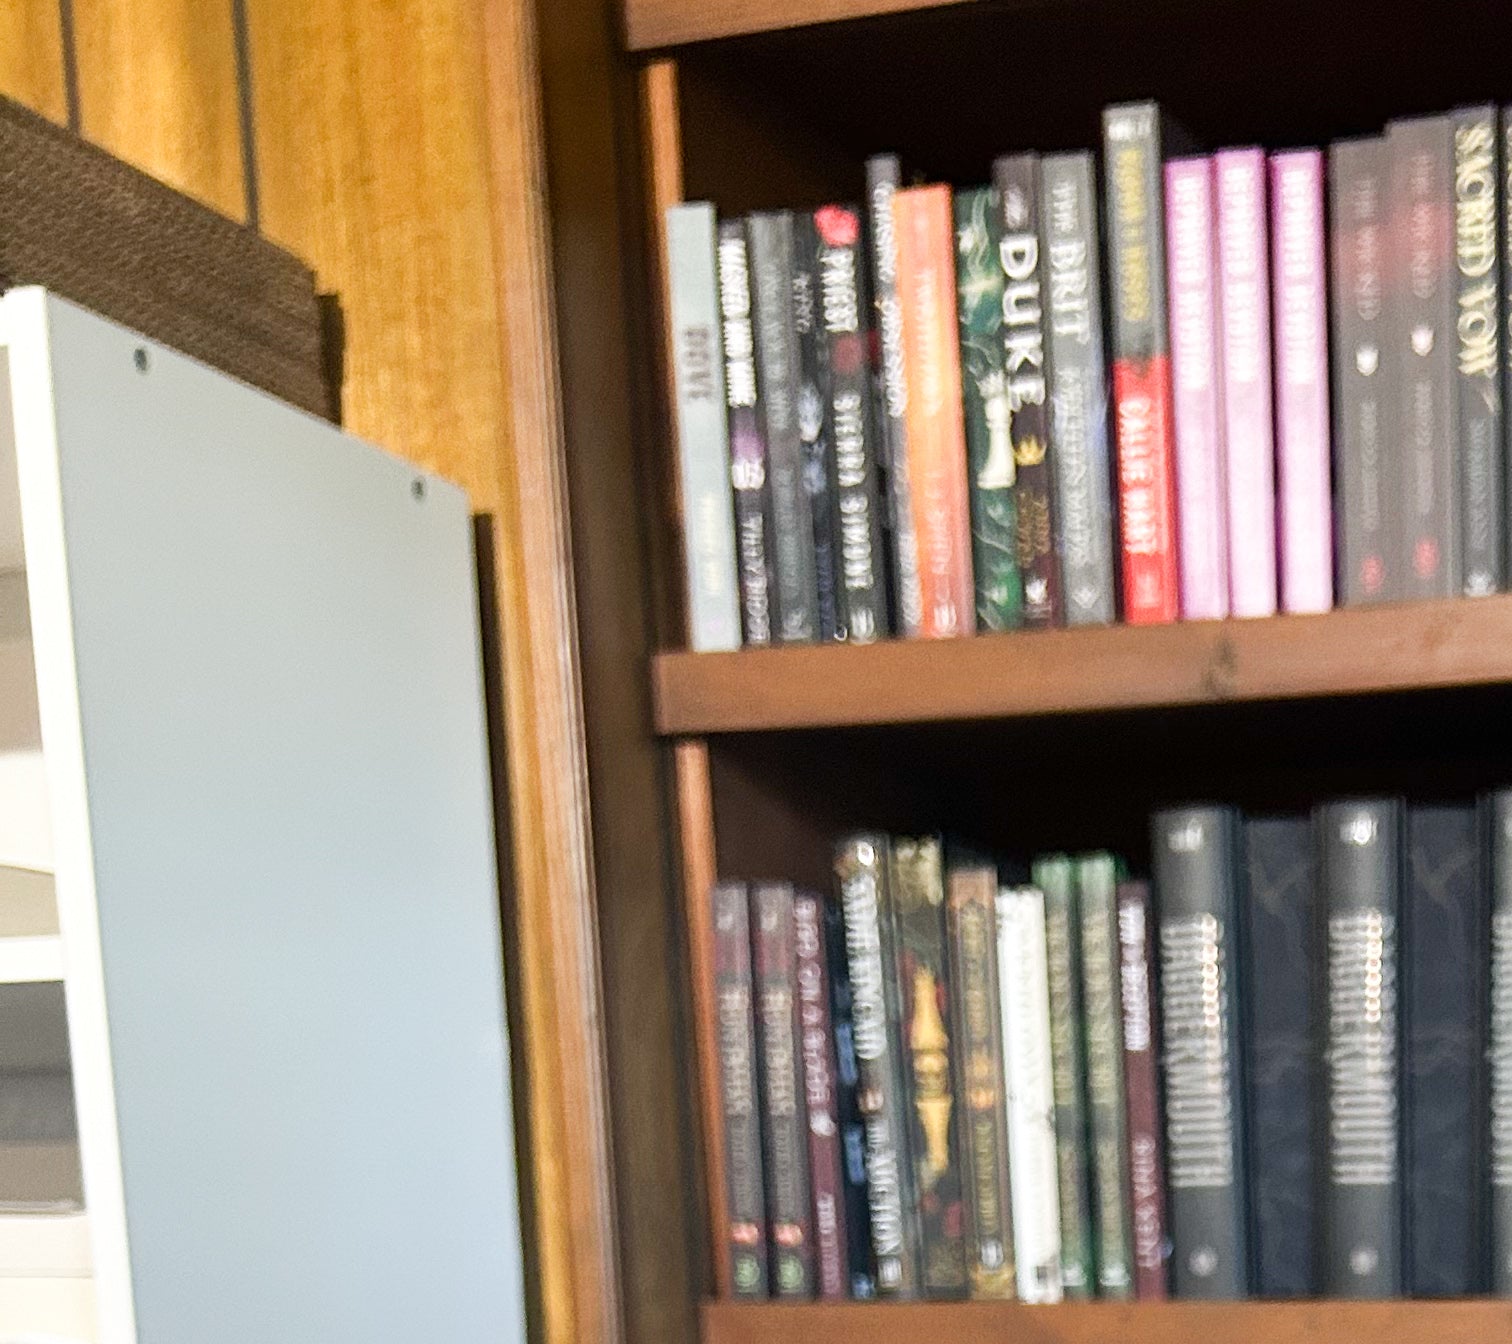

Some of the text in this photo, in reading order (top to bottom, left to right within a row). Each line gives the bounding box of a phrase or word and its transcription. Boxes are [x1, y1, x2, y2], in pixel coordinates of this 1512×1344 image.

[1456, 120, 1497, 277] SACRED
[820, 249, 860, 334] PRIEST
[999, 234, 1046, 412] DUKE
[1050, 239, 1090, 346] BRIT
[1458, 281, 1499, 378] VOW
[833, 393, 873, 592] SIERRA SIMONE
